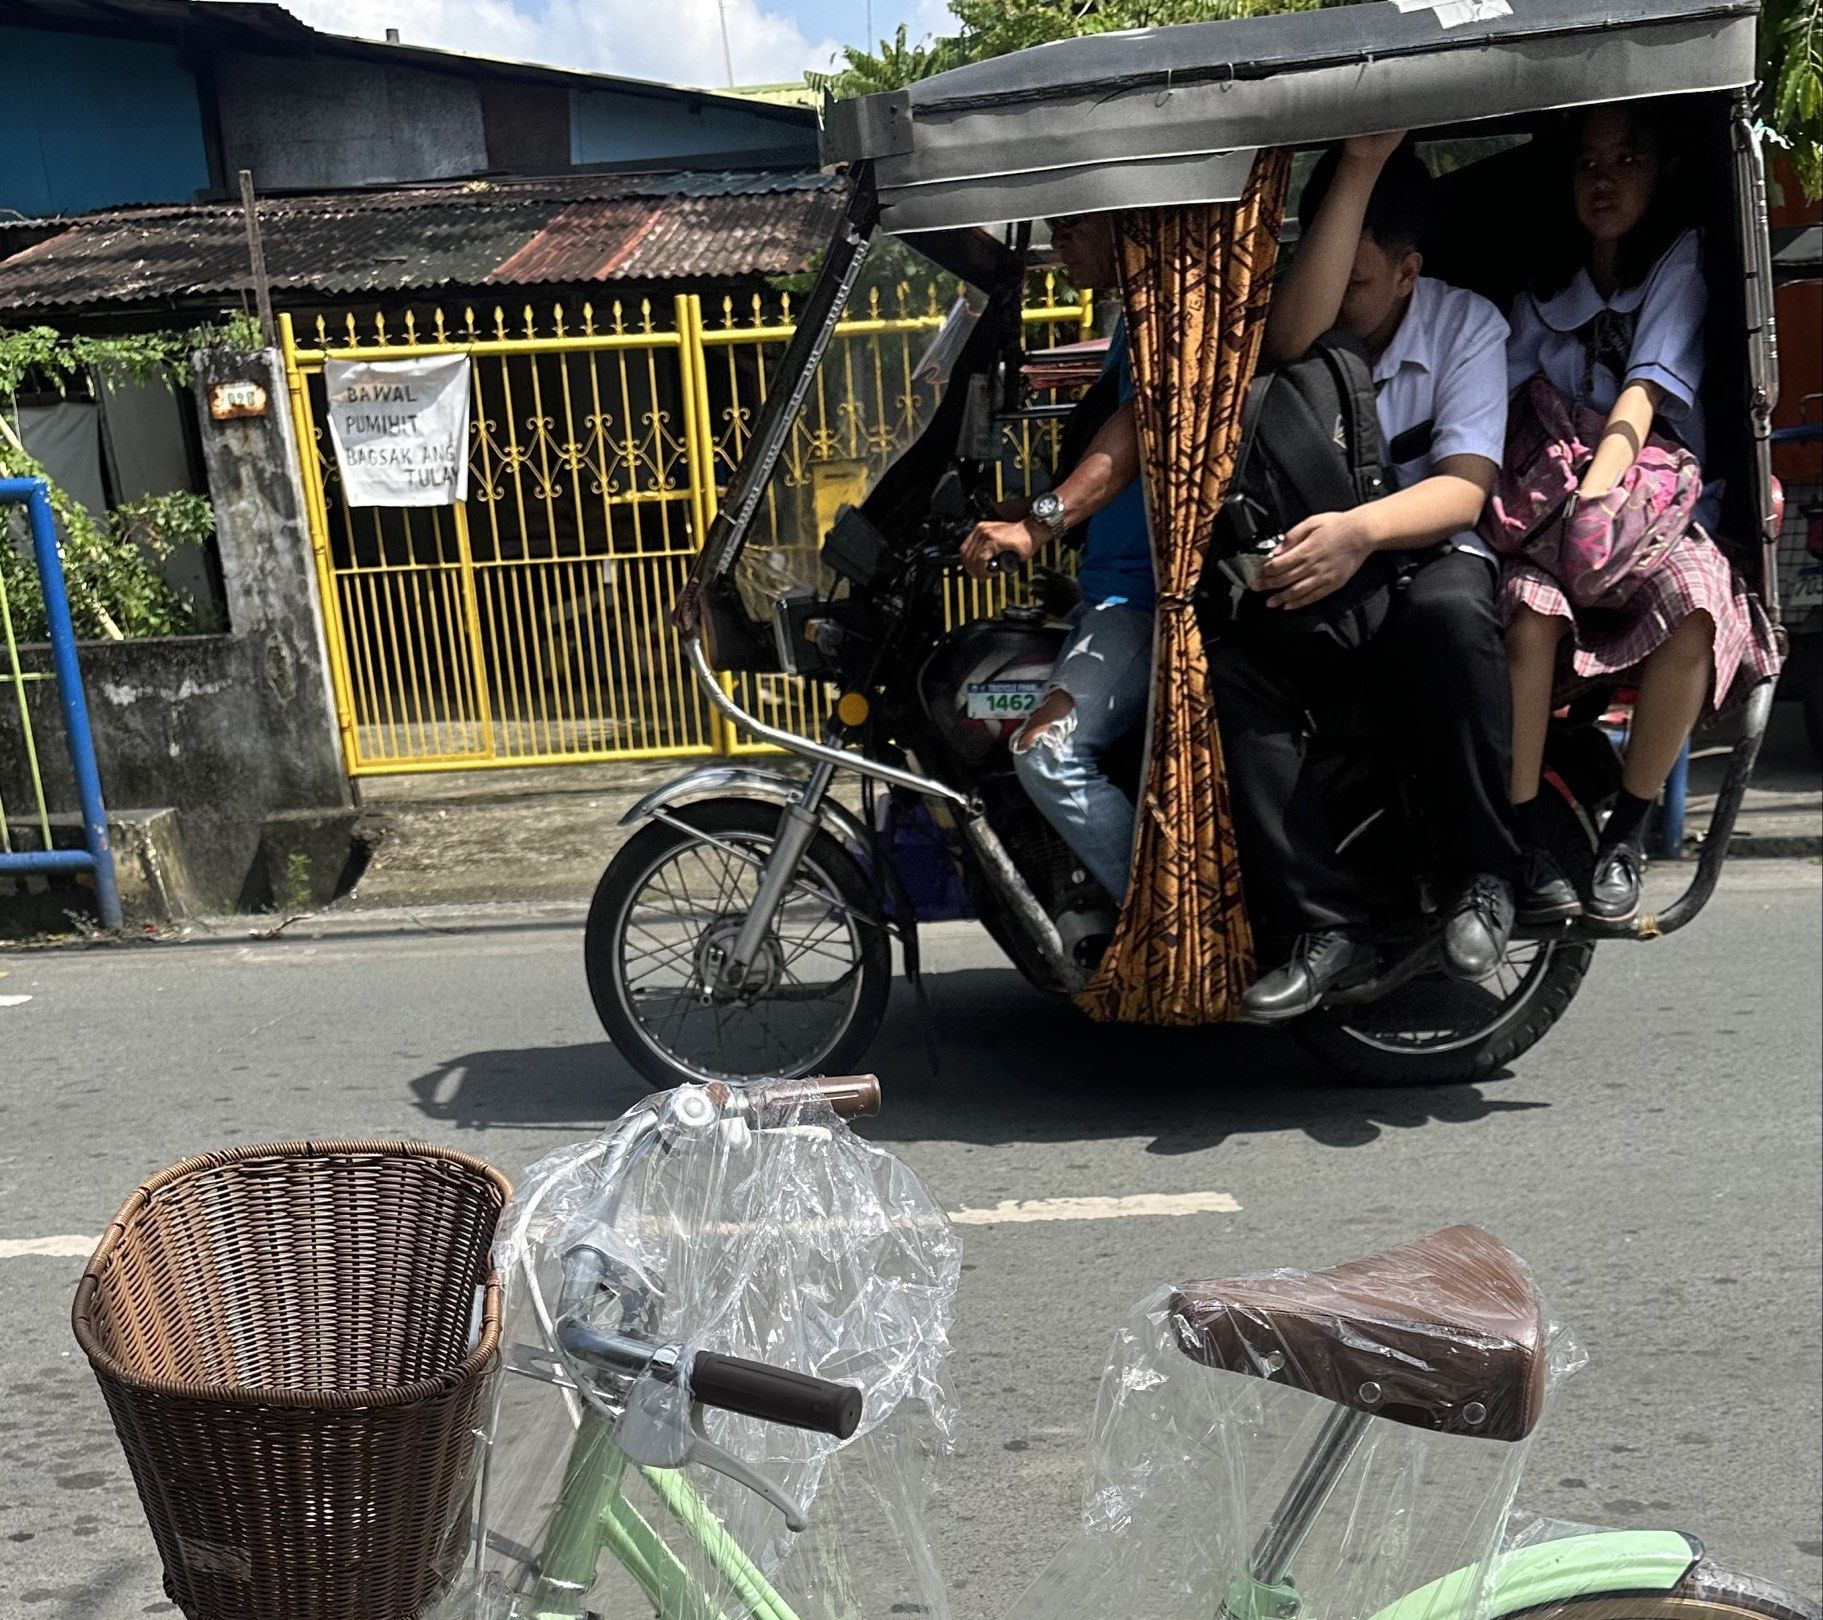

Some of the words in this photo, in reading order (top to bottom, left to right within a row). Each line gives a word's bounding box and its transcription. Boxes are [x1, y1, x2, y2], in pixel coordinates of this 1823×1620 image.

[346, 385, 418, 403] BAWAL
[346, 447, 413, 466] BAGSAK
[422, 444, 456, 464] ANG
[986, 694, 1036, 711] 1462
